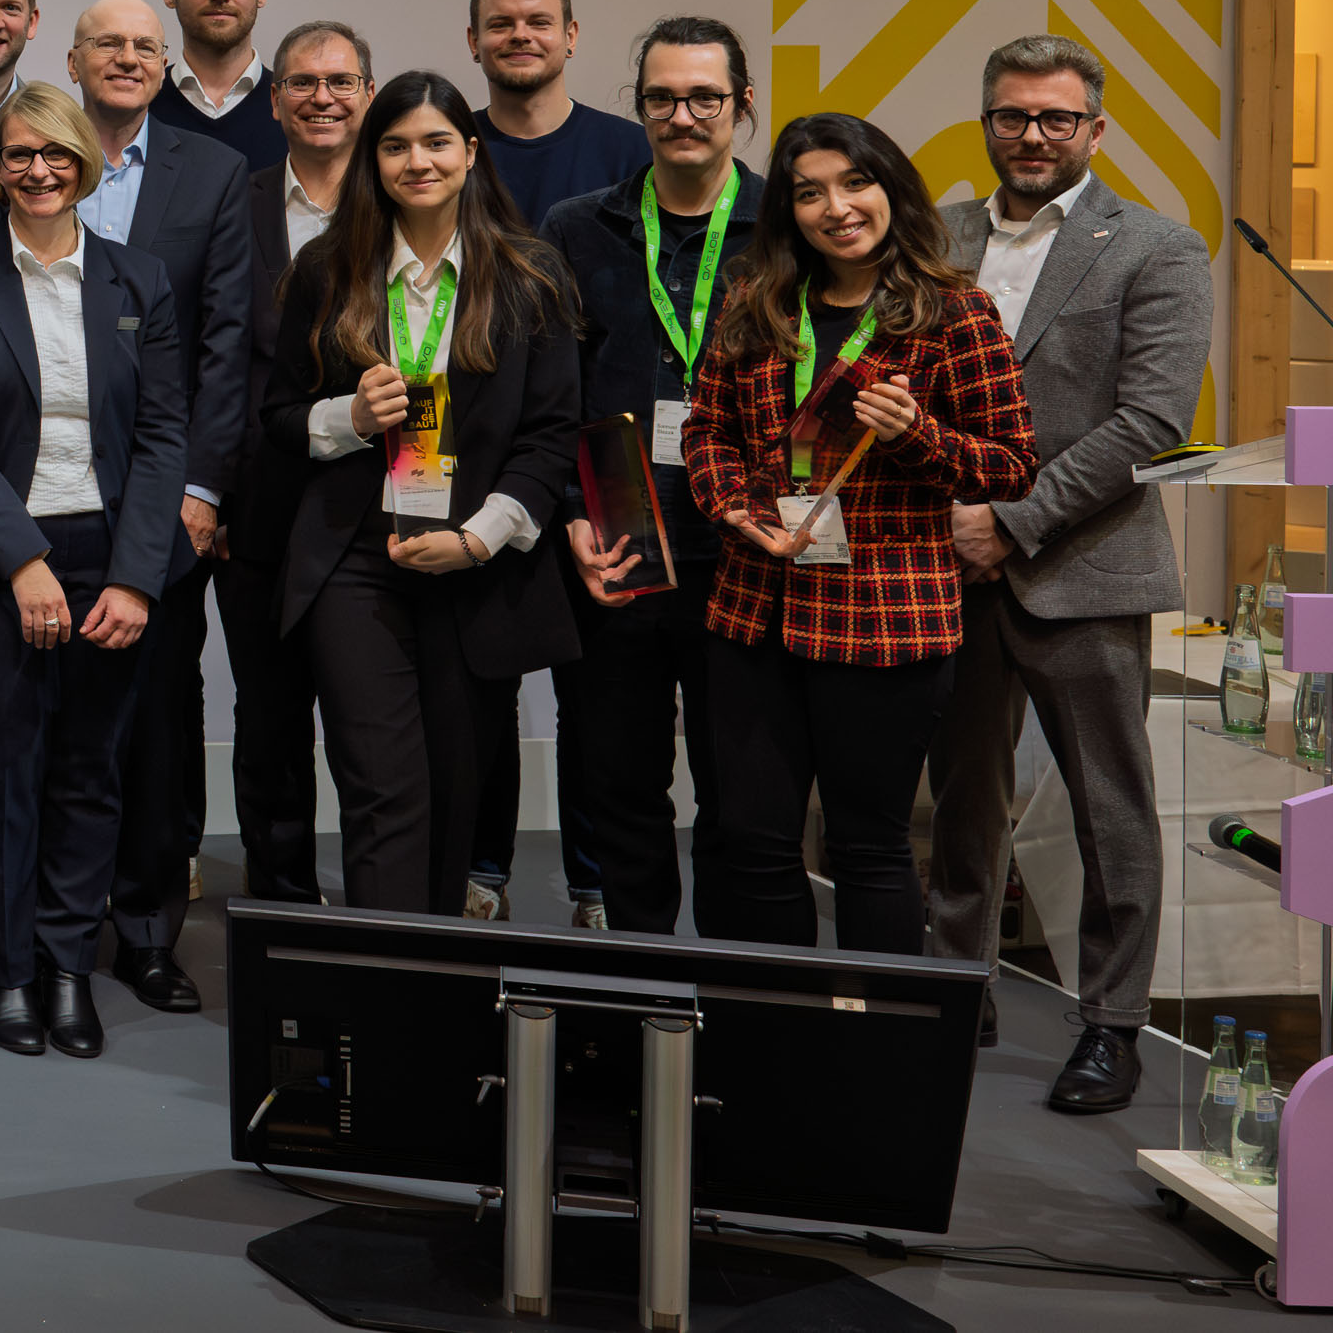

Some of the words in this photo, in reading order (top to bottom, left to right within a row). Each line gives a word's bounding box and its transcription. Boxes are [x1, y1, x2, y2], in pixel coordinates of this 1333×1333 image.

[702, 230, 720, 281] BOTEVO
[435, 299, 447, 318] BAU
[392, 297, 407, 346] BOTEVO
[421, 414, 435, 422] GE
[424, 407, 434, 415] IT
